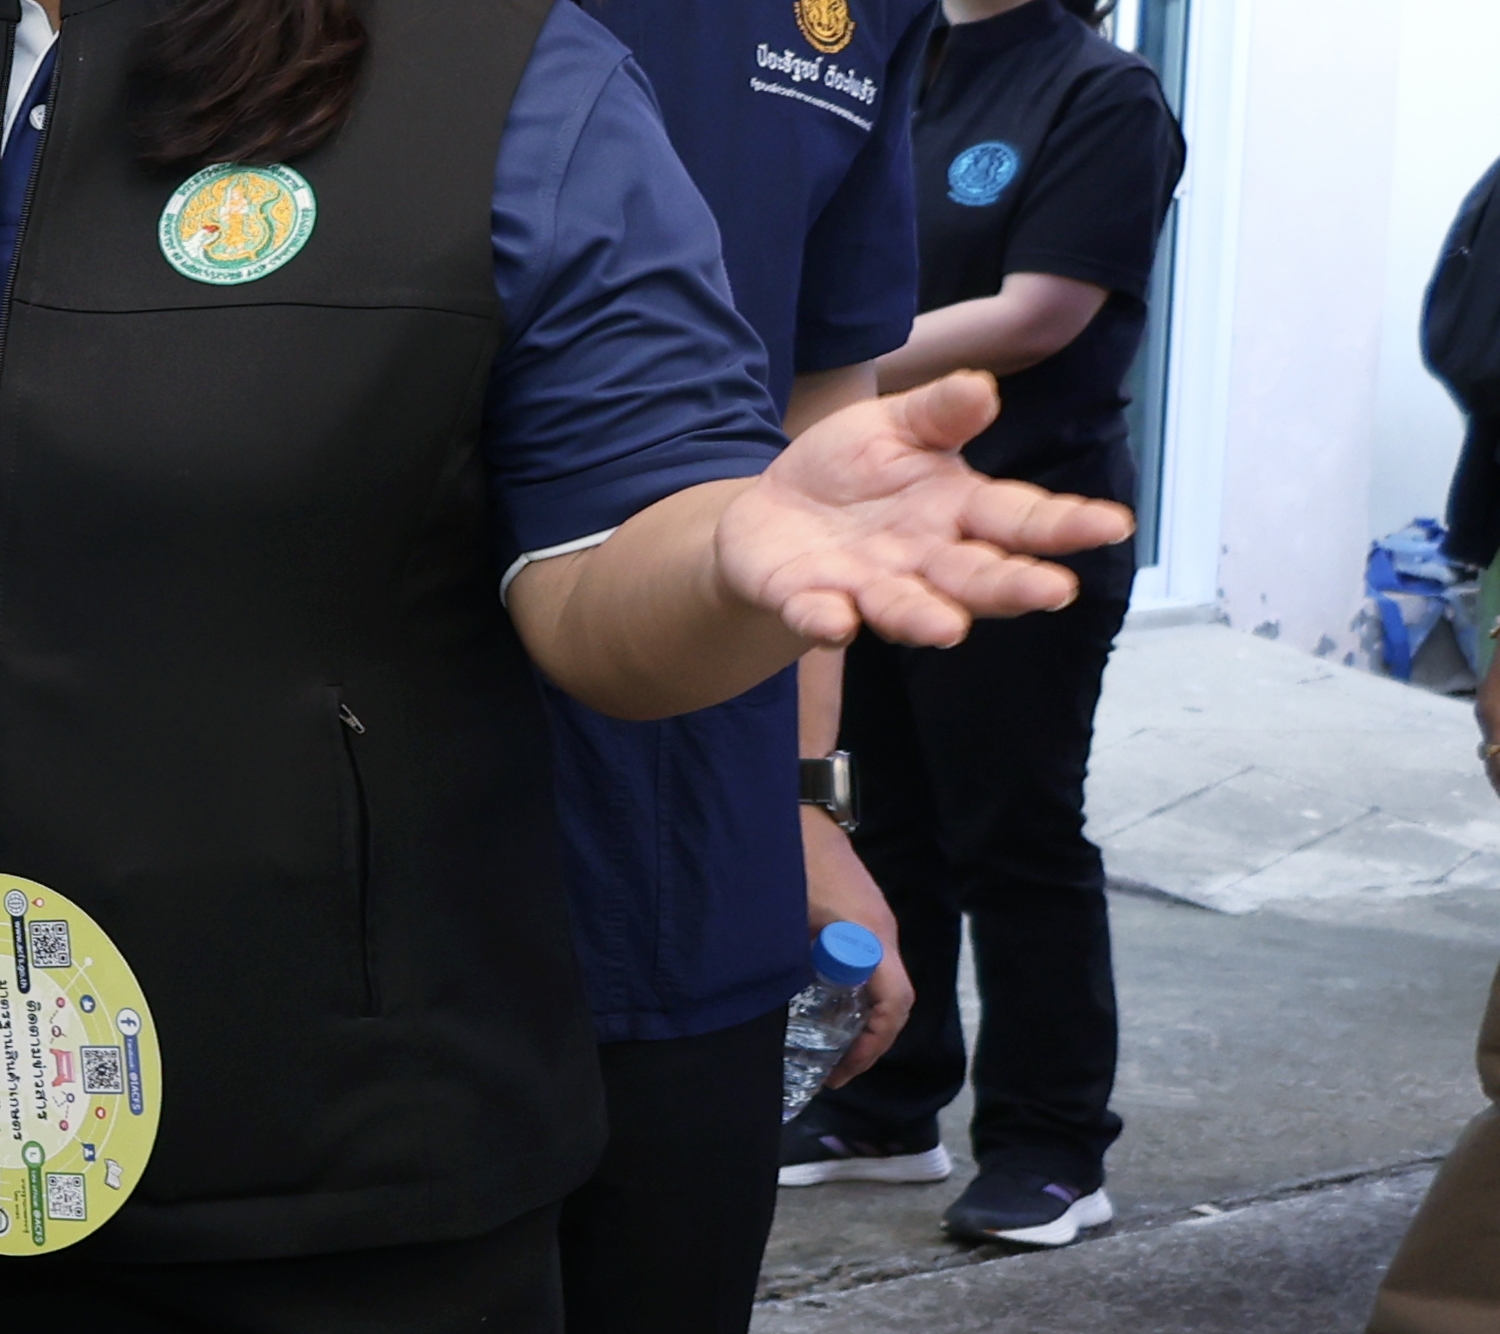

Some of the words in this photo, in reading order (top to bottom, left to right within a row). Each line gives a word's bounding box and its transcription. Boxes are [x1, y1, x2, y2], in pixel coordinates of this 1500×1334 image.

[25, 1000, 49, 1120] ติดตามข่าวสาร
